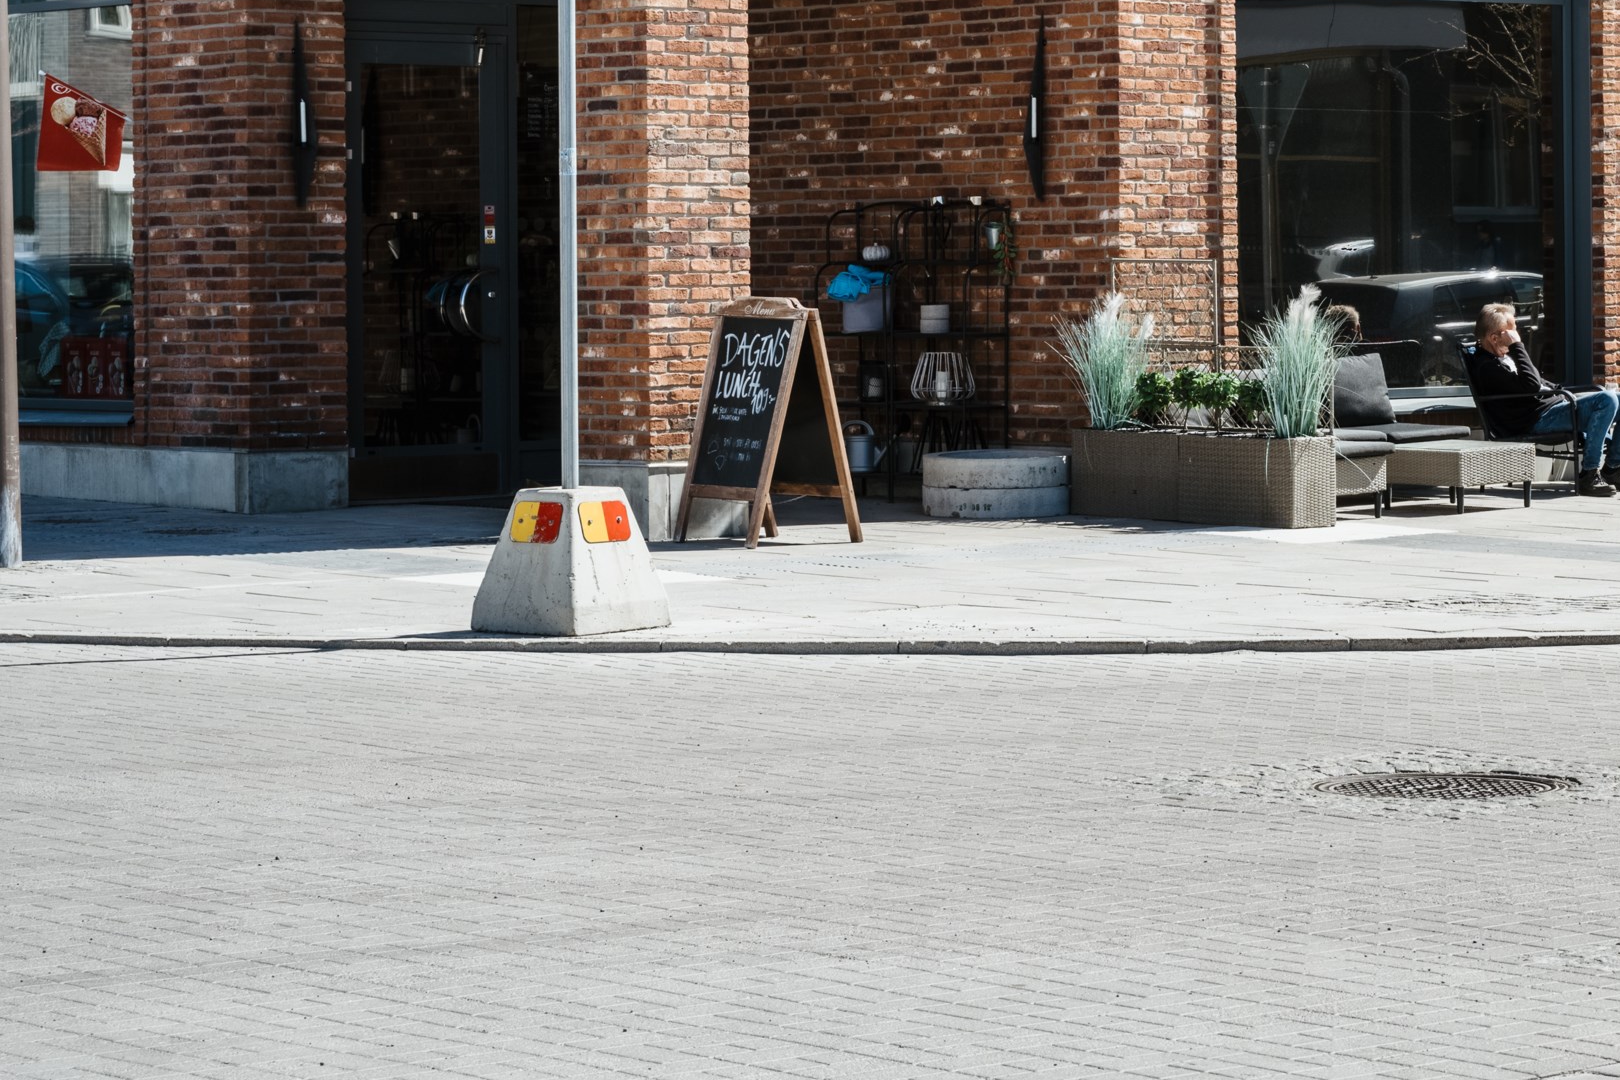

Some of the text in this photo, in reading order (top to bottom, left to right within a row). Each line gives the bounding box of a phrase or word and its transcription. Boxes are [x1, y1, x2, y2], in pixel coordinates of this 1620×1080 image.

[744, 300, 776, 316] Menu
[721, 327, 791, 375] DAGENS
[715, 369, 762, 399] LUNCH
